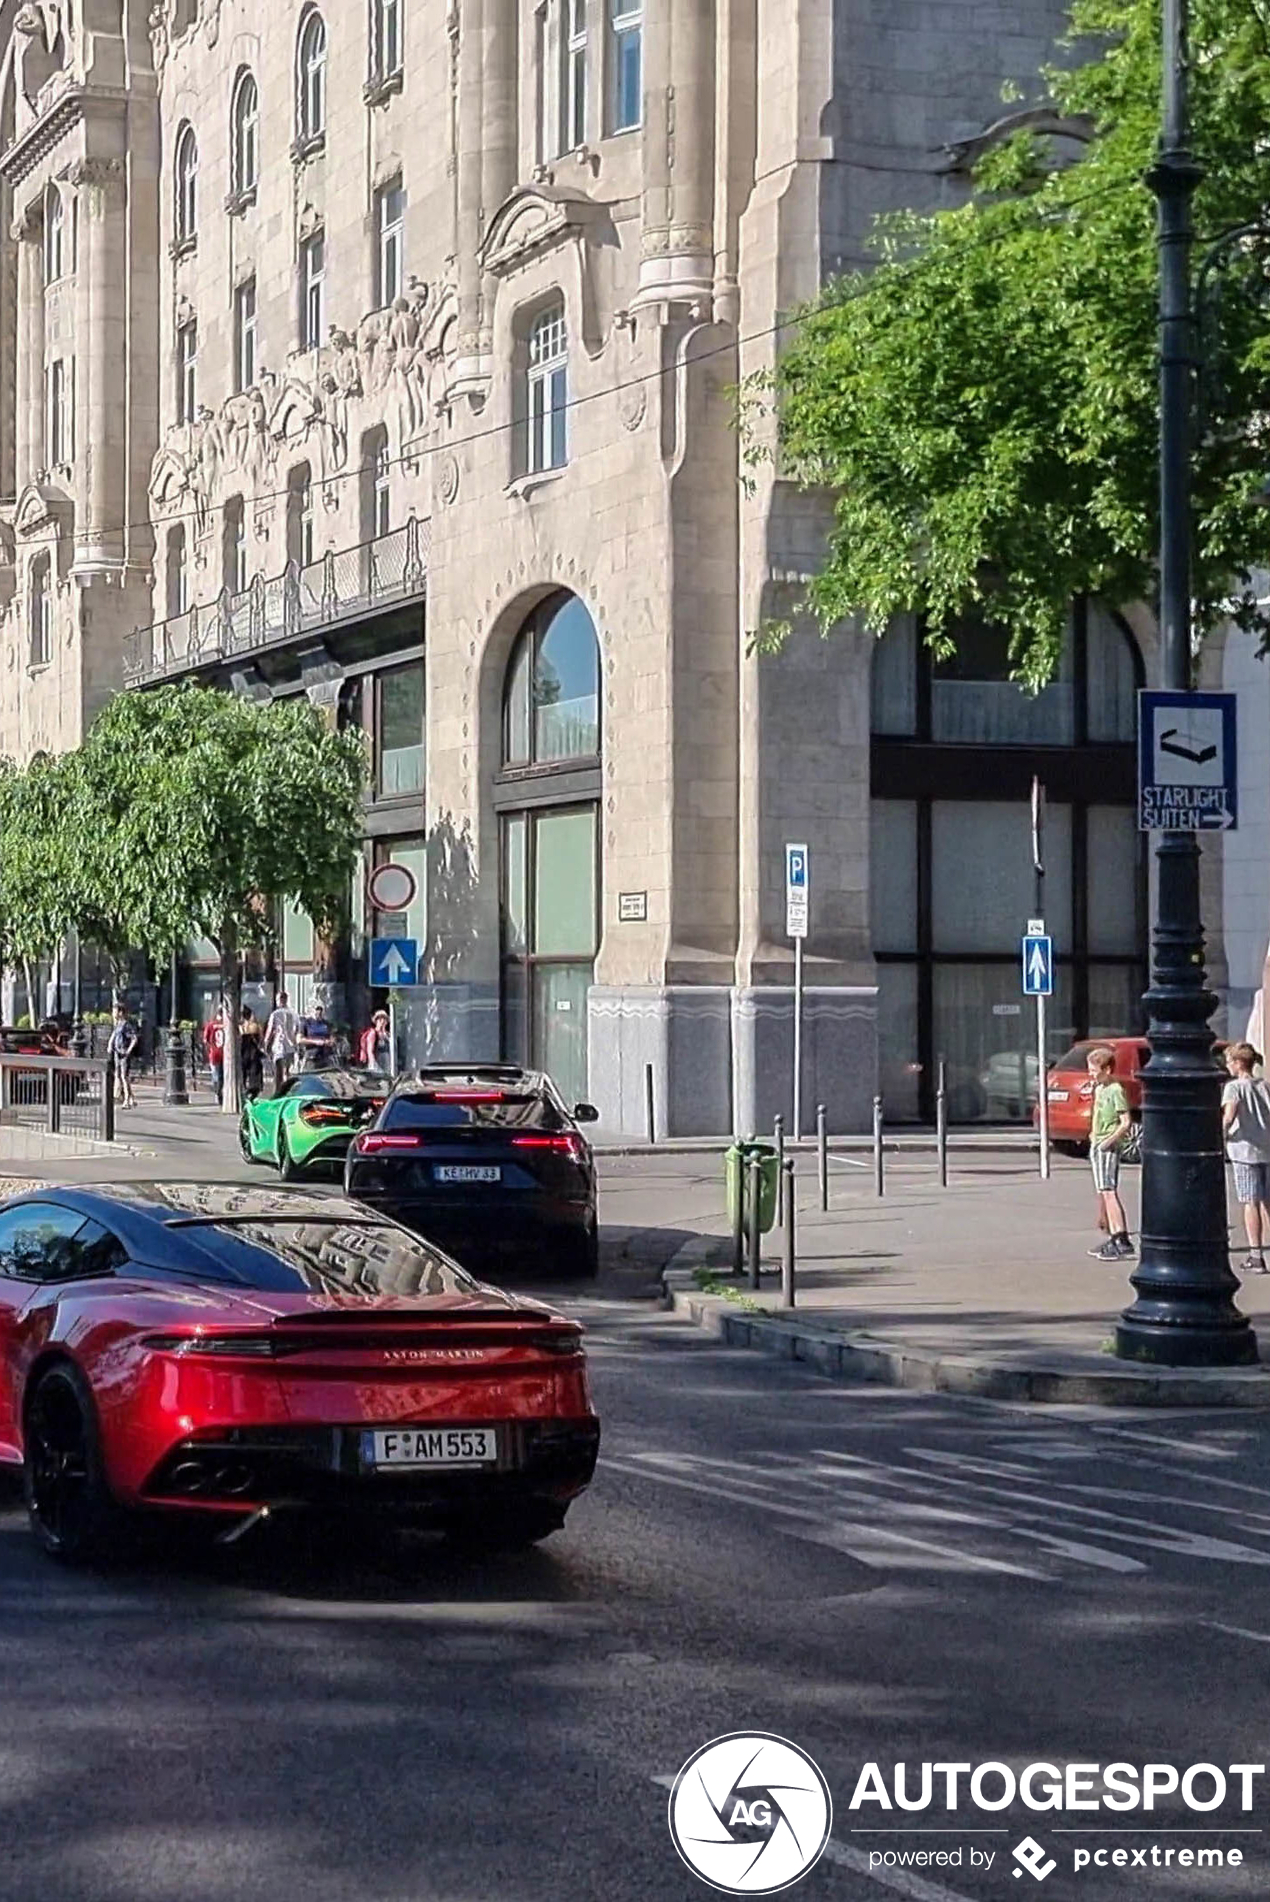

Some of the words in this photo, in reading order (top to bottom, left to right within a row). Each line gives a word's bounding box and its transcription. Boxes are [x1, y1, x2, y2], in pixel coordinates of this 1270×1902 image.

[1143, 787, 1227, 807] STARLIGHT
[1143, 808, 1200, 829] SUITEN
[792, 856, 802, 883] P
[384, 1434, 397, 1458] F
